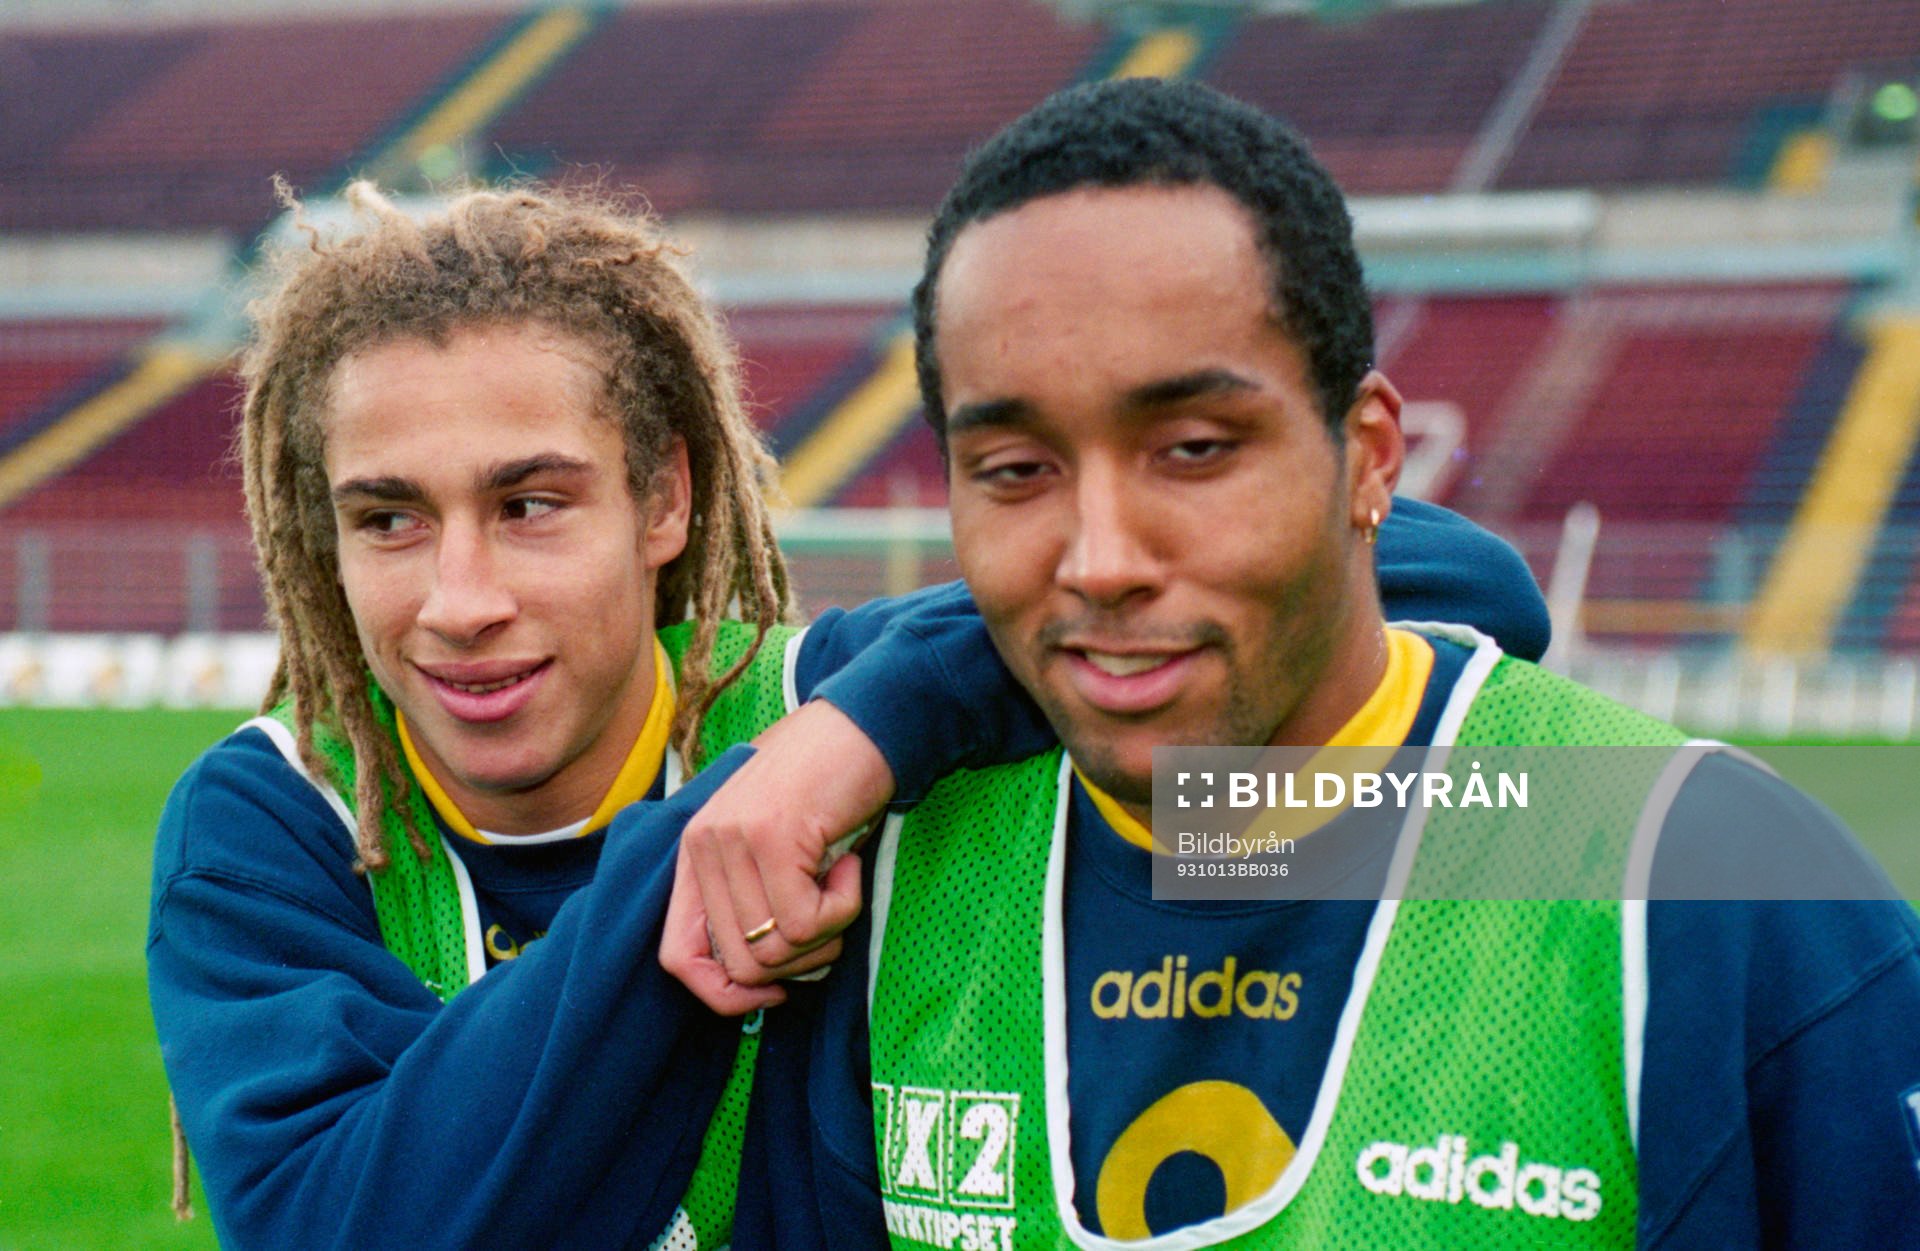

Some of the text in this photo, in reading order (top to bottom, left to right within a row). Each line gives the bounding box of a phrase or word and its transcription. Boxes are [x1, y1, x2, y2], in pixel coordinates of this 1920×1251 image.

[1091, 954, 1302, 1020] adidas
[957, 1103, 1009, 1196] 2
[1357, 1134, 1602, 1222] adidas
